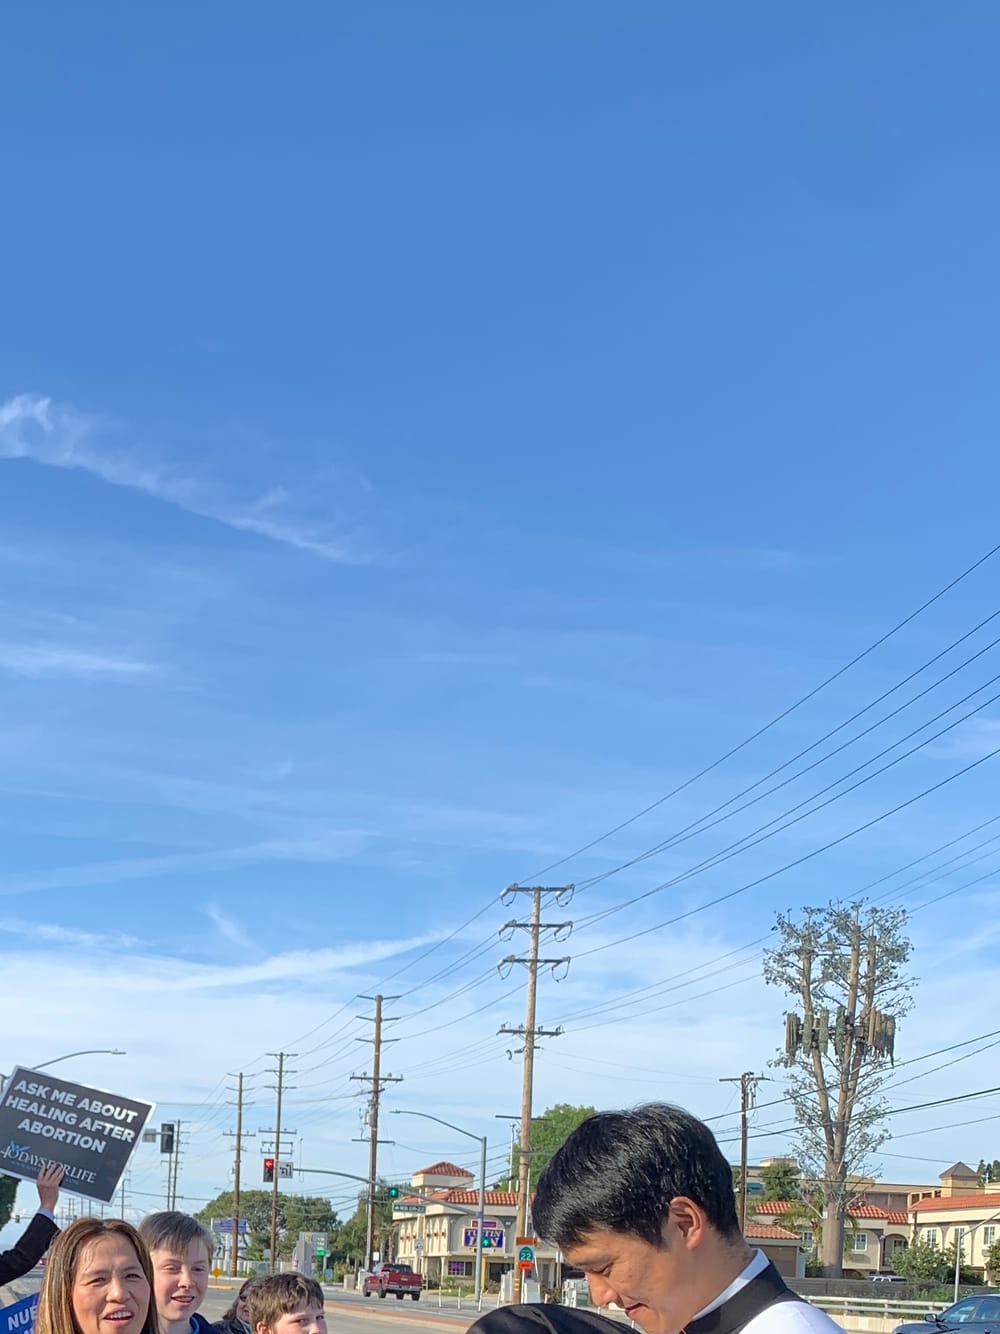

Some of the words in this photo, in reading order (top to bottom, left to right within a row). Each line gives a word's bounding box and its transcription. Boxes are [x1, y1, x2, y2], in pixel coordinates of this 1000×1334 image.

[5, 1095, 78, 1125] HEALING
[79, 1117, 136, 1143] AFTER
[14, 1080, 51, 1099] ASK
[50, 1089, 77, 1106] ME
[77, 1098, 138, 1123] ABOUT
[17, 1118, 106, 1153] ABORTION
